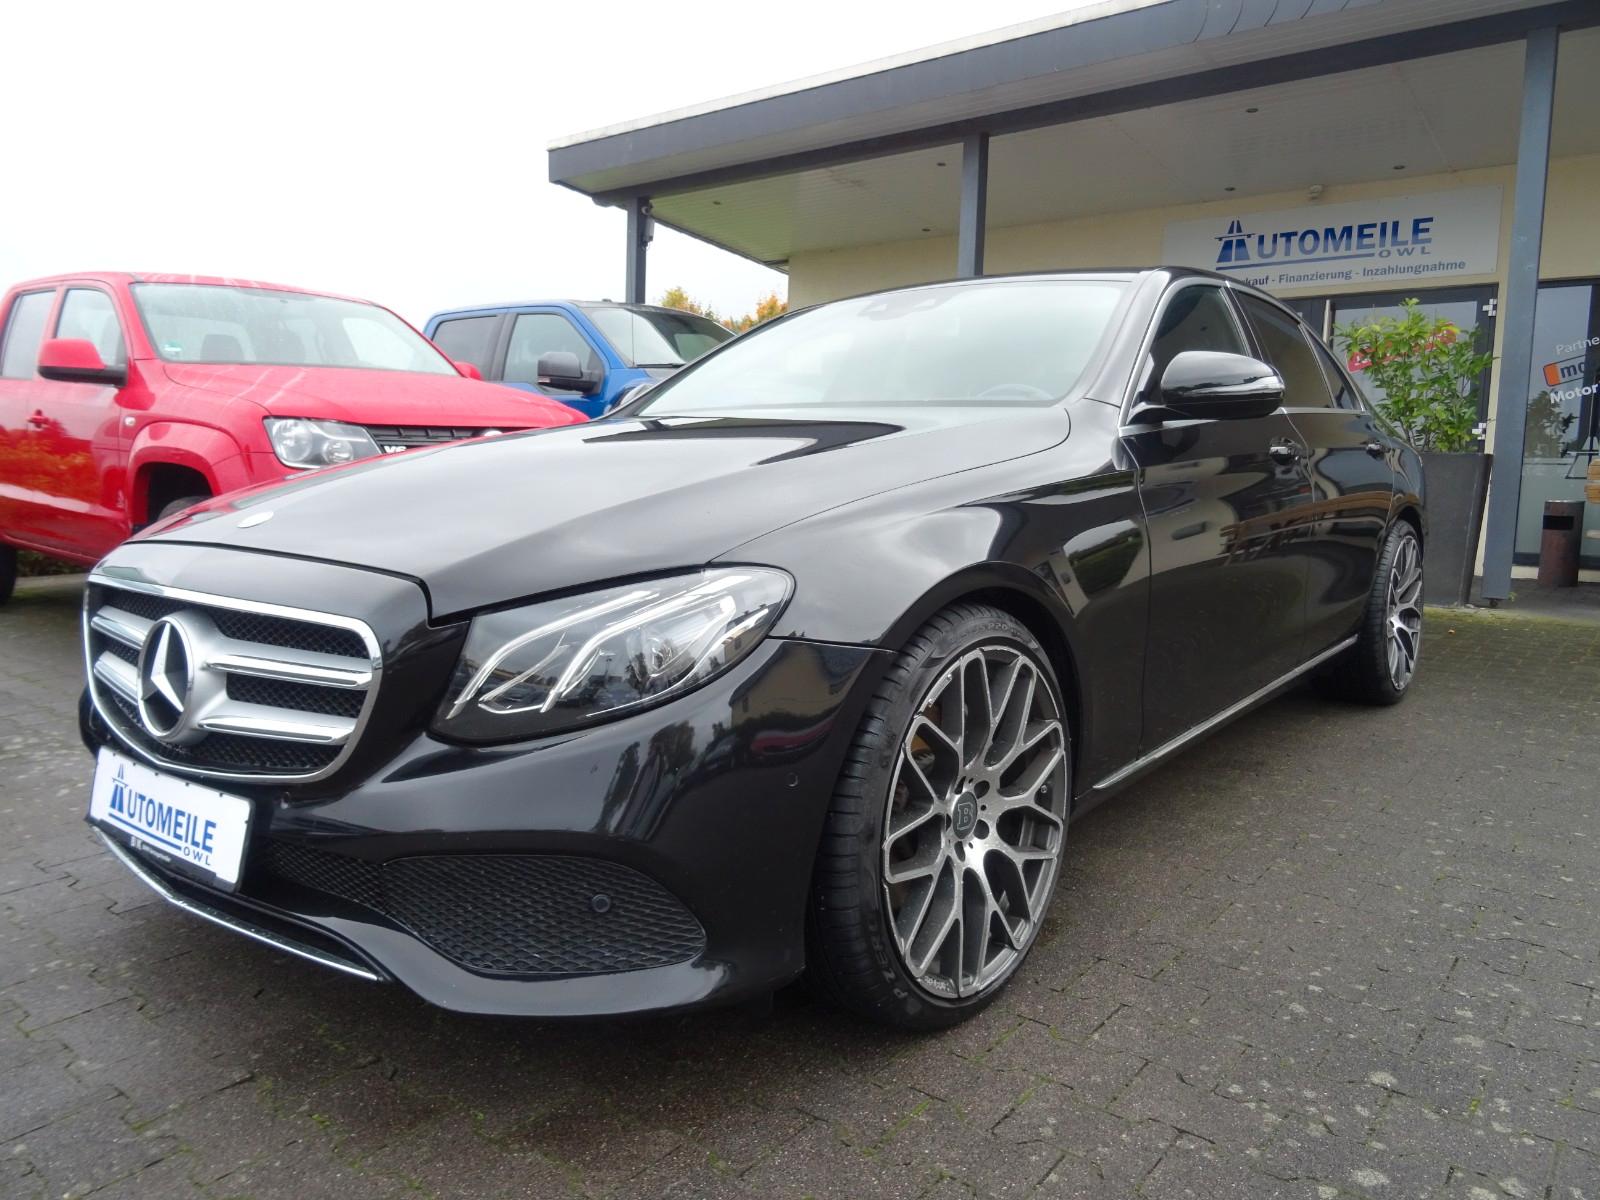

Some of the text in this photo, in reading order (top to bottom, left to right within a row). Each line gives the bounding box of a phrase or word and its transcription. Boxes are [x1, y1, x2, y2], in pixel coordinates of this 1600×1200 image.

[1378, 246, 1431, 258] OWL
[1245, 275, 1270, 288] kauf
[1279, 270, 1352, 283] Finanzierung
[1363, 260, 1466, 276] Inzahlungnahme
[384, 445, 407, 453] V6
[183, 846, 211, 865] OWL
